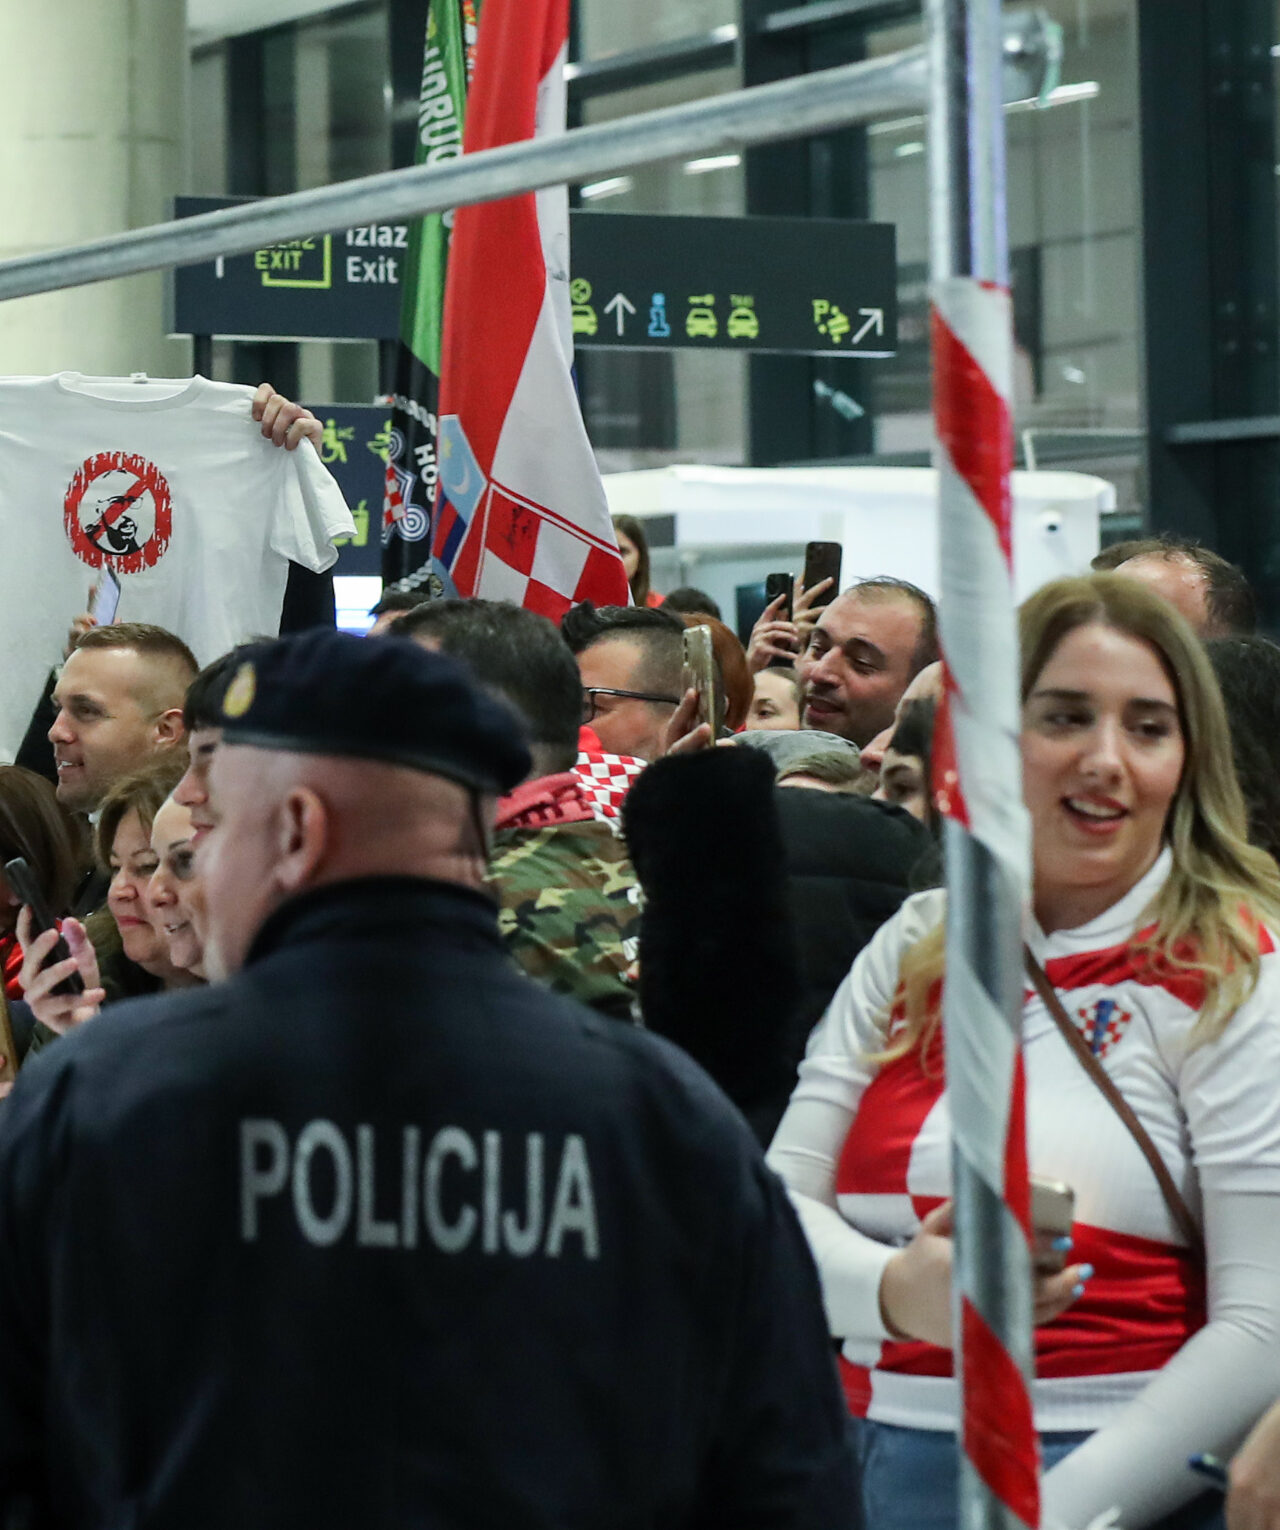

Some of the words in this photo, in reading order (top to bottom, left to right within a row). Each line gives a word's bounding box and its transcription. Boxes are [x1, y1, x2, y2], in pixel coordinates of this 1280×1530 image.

[255, 250, 303, 270] EXIT
[346, 256, 399, 283] Exit
[239, 1118, 600, 1260] POLICIJA
